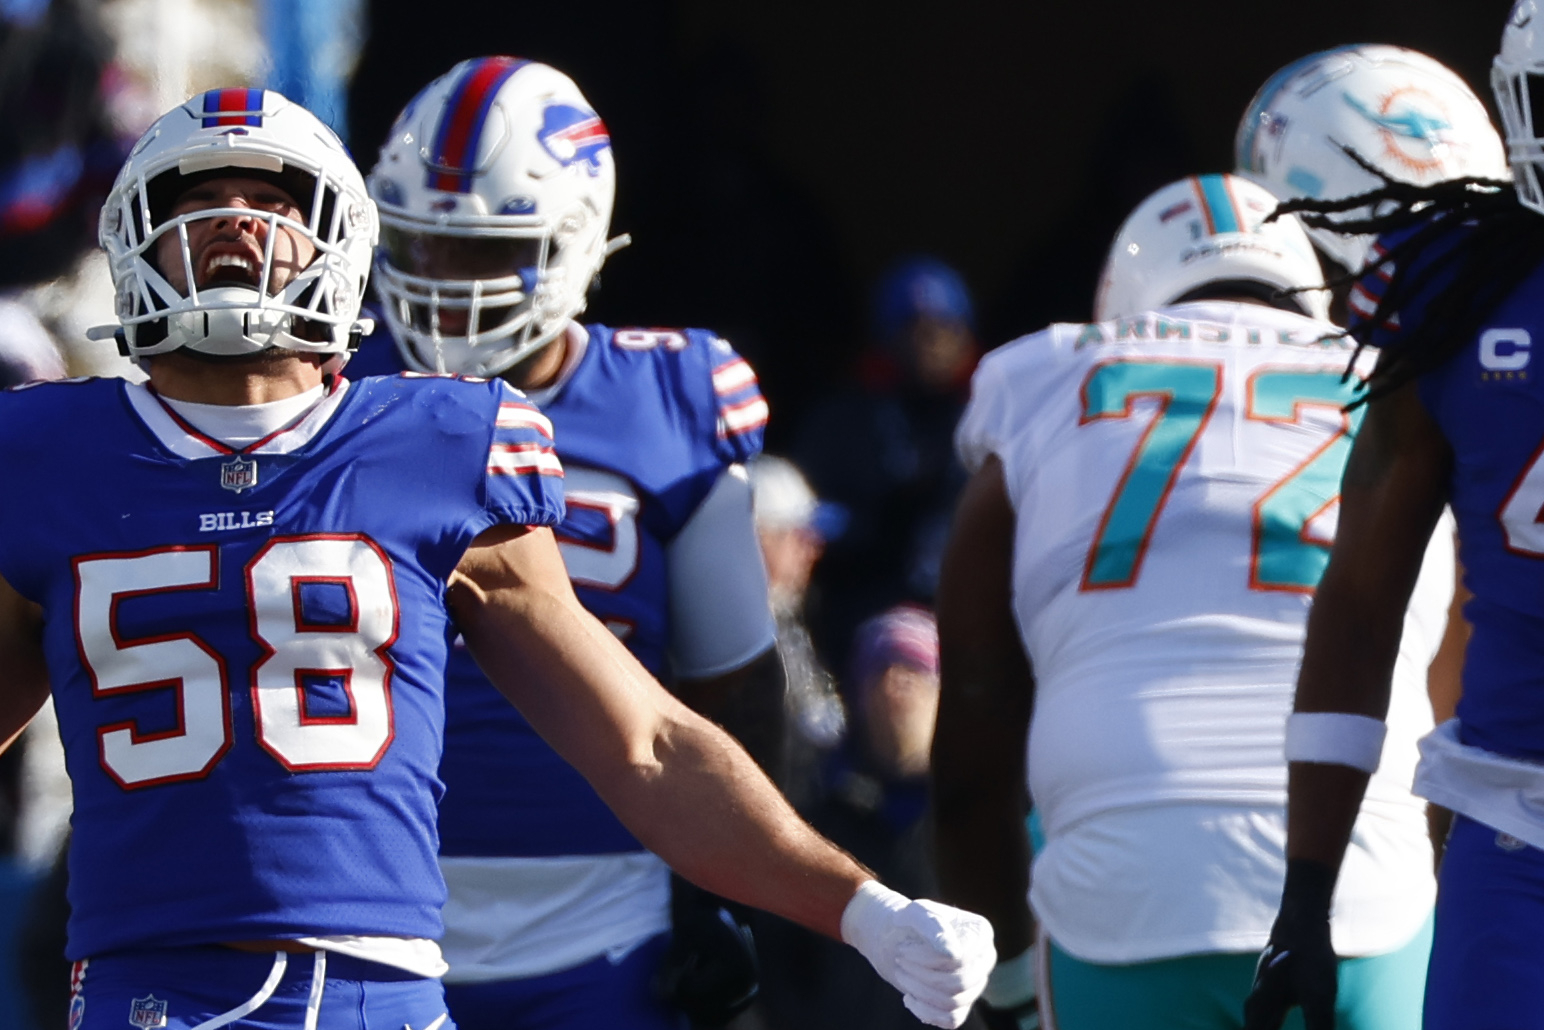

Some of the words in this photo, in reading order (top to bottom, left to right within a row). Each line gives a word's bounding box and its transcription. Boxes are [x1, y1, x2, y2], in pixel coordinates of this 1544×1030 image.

[1478, 327, 1532, 371] C
[199, 510, 274, 532] BILLS
[1078, 356, 1371, 595] 72
[70, 532, 401, 791] 58
